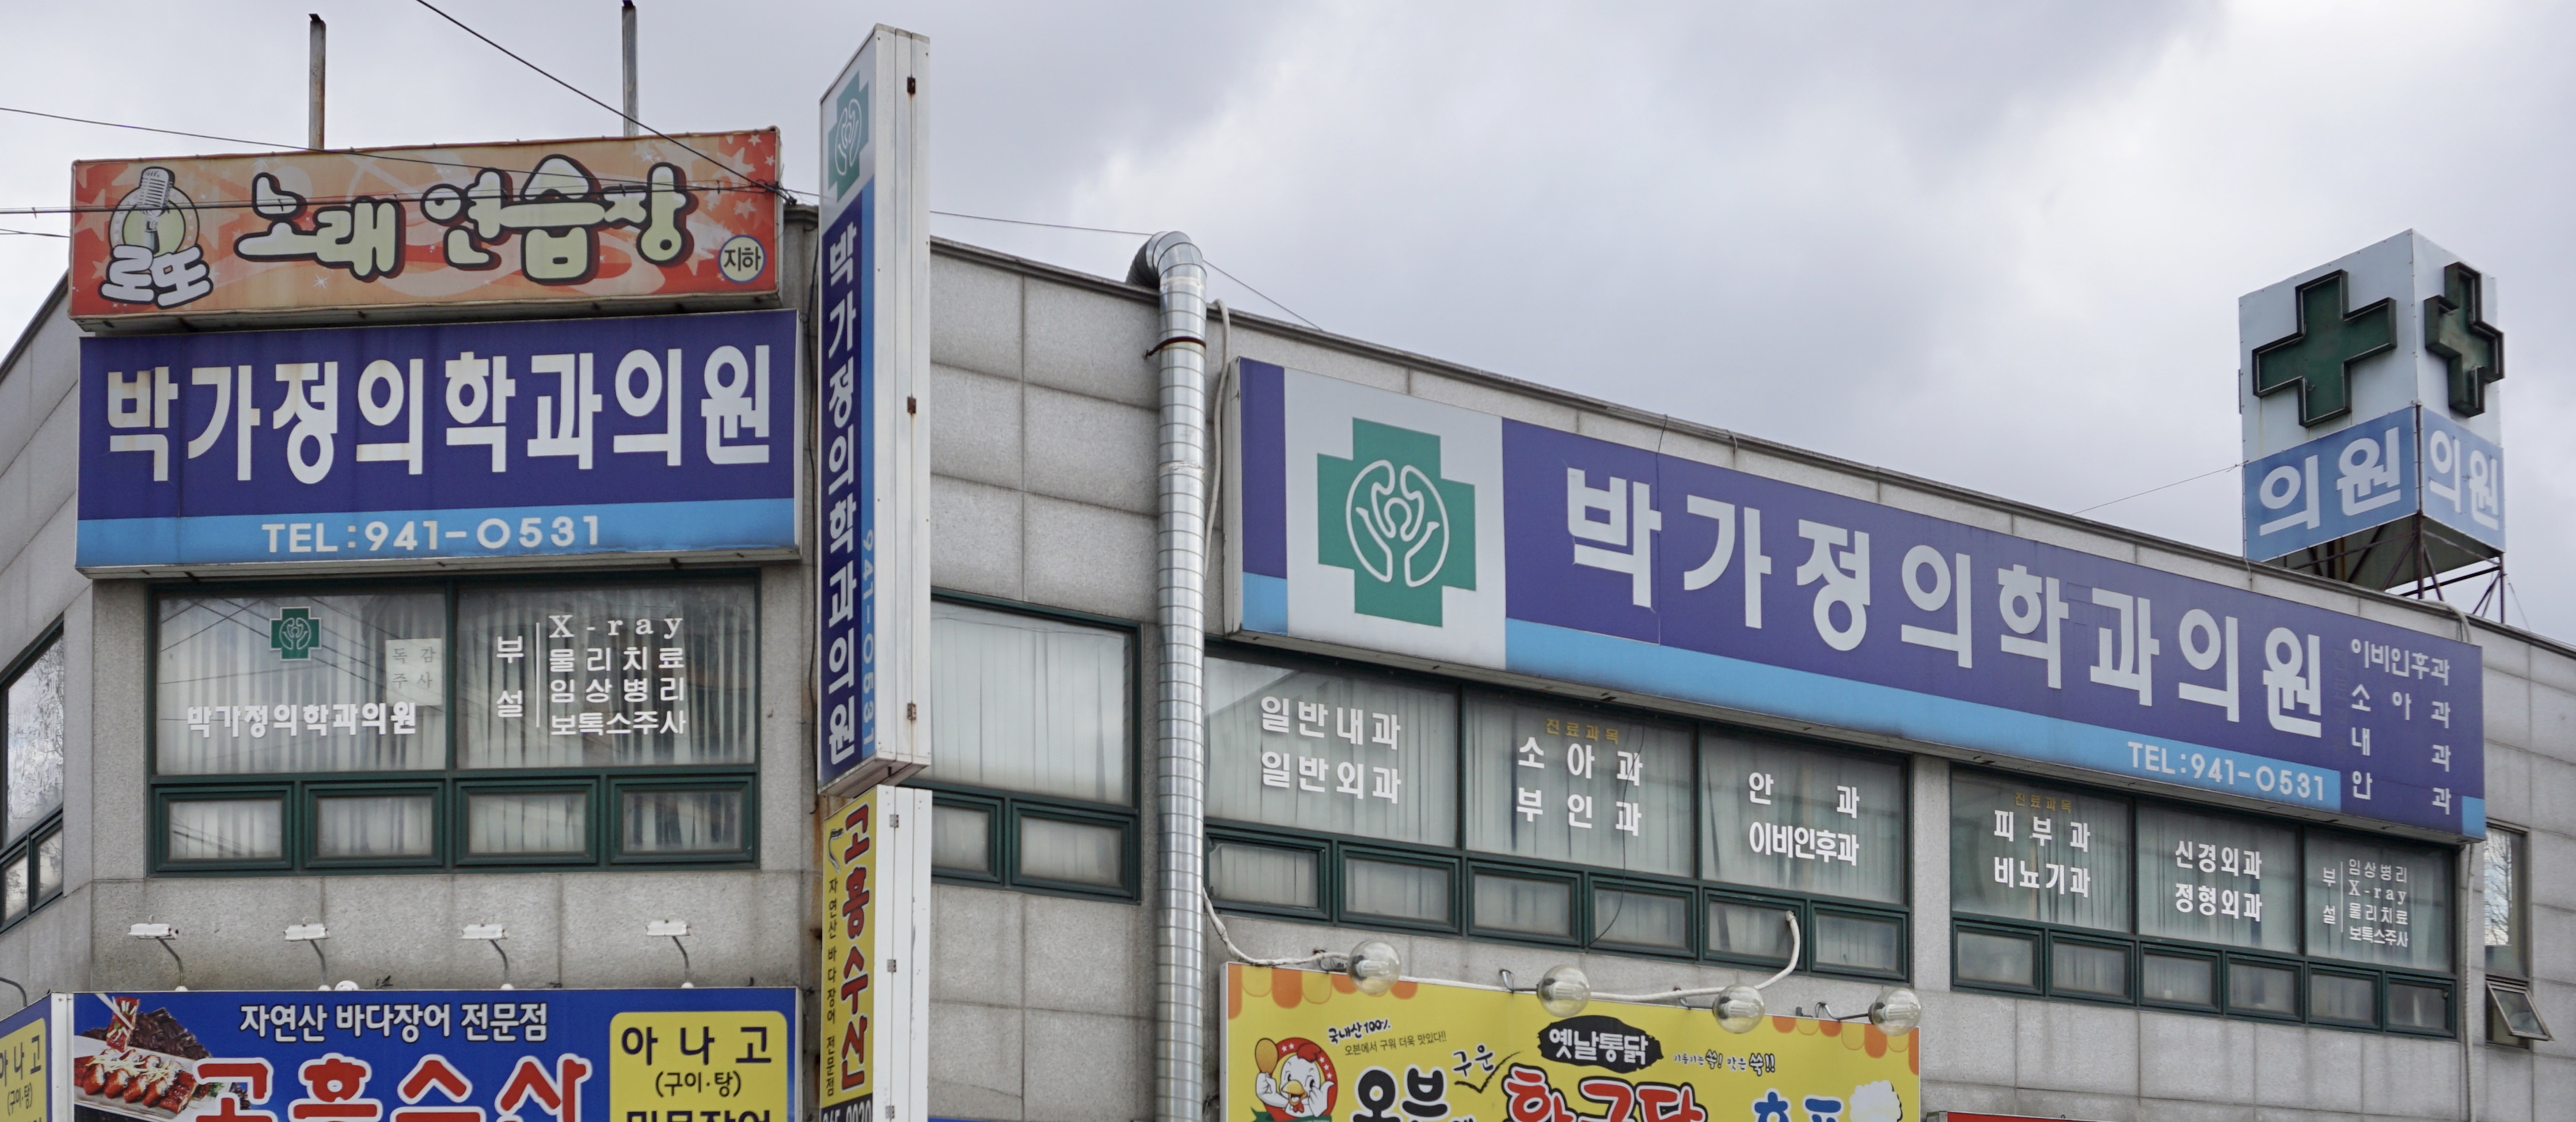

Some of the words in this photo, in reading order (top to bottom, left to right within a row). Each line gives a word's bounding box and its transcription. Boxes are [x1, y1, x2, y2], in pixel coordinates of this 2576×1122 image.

[235, 172, 404, 280] 노래
[420, 154, 692, 283] 연습장
[99, 244, 214, 309] 로또
[724, 248, 761, 272] 지하
[107, 345, 770, 485] 박가정의학과의원
[828, 221, 857, 765] 박가정의학과의원
[2259, 427, 2401, 536] 의원
[2430, 430, 2499, 530] 의원
[1566, 465, 2322, 738] 박가정의학과의원
[549, 615, 683, 639] X-ray
[863, 529, 874, 745] 941-0531
[550, 647, 685, 672] 물리치료
[2351, 639, 2450, 685] 이비인후과
[550, 677, 685, 703] 임상병리
[187, 702, 416, 738] 박가정의학과의원
[550, 712, 686, 737] 보톡스주사
[1261, 696, 1401, 750] 일반내과
[1546, 719, 1619, 745] 진료과목
[1262, 752, 1401, 804] 일반외과
[2015, 793, 2071, 813] 진료과목
[1749, 821, 1859, 866] 이비인후과
[2175, 840, 2262, 880] 신경외과
[1994, 856, 2091, 898] 비뇨기과
[2349, 859, 2407, 884] 임상병리
[2175, 883, 2262, 922] 정형외과
[2348, 881, 2407, 905] X-ray
[2349, 903, 2408, 926] 물리치료
[841, 803, 870, 1091] 고흥수산
[2349, 927, 2408, 948] 보톡스주사
[241, 1005, 326, 1042] 자연산
[337, 1004, 450, 1043] 바다장어
[461, 1002, 548, 1042] 전문점
[826, 1035, 835, 1097] 전문점
[1345, 1041, 1378, 1056] 오븐에서
[1380, 1038, 1397, 1052] 구워
[1400, 1036, 1415, 1048] 더욱
[1453, 1045, 1494, 1077] 구운
[1549, 1028, 1648, 1066] 옛날통닭
